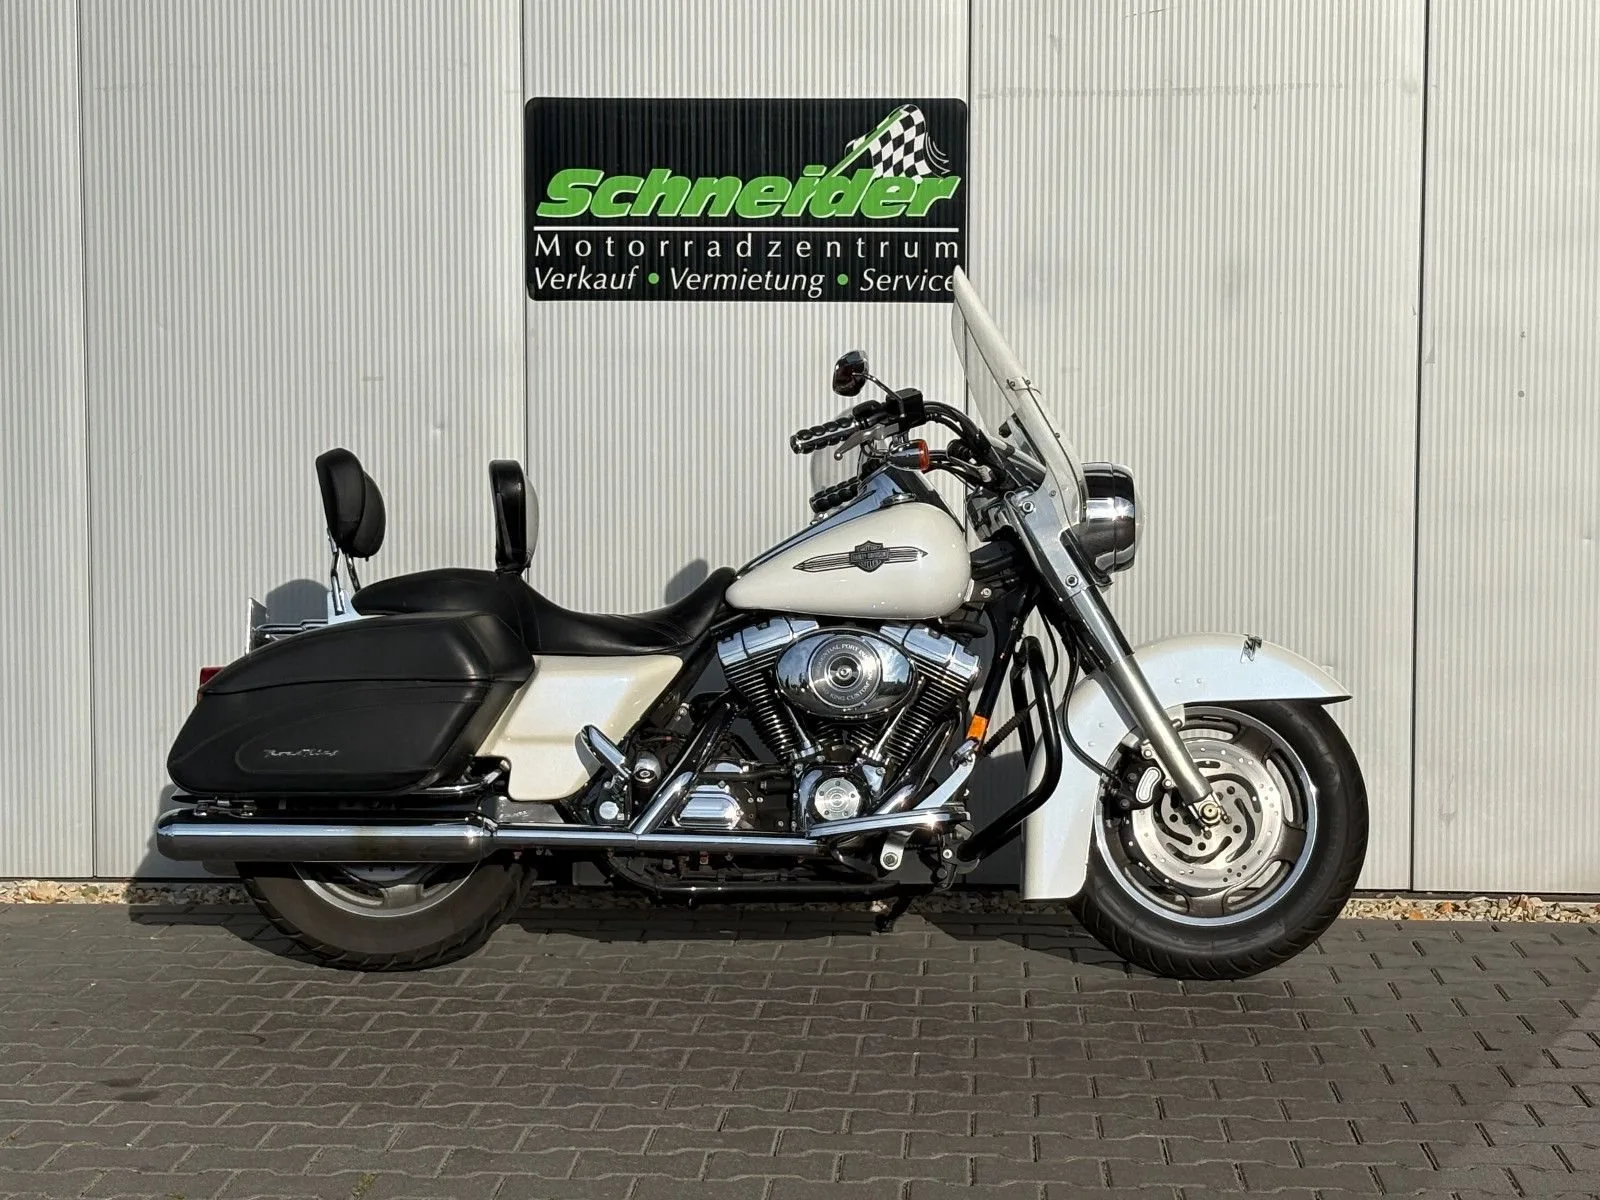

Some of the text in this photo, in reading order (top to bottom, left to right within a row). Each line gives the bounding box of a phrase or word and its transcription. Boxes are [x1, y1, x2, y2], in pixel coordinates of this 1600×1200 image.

[535, 165, 961, 220] Schneider
[536, 233, 957, 258] Motorradzentrum
[536, 265, 954, 298] Verkauf Vermietung Service
